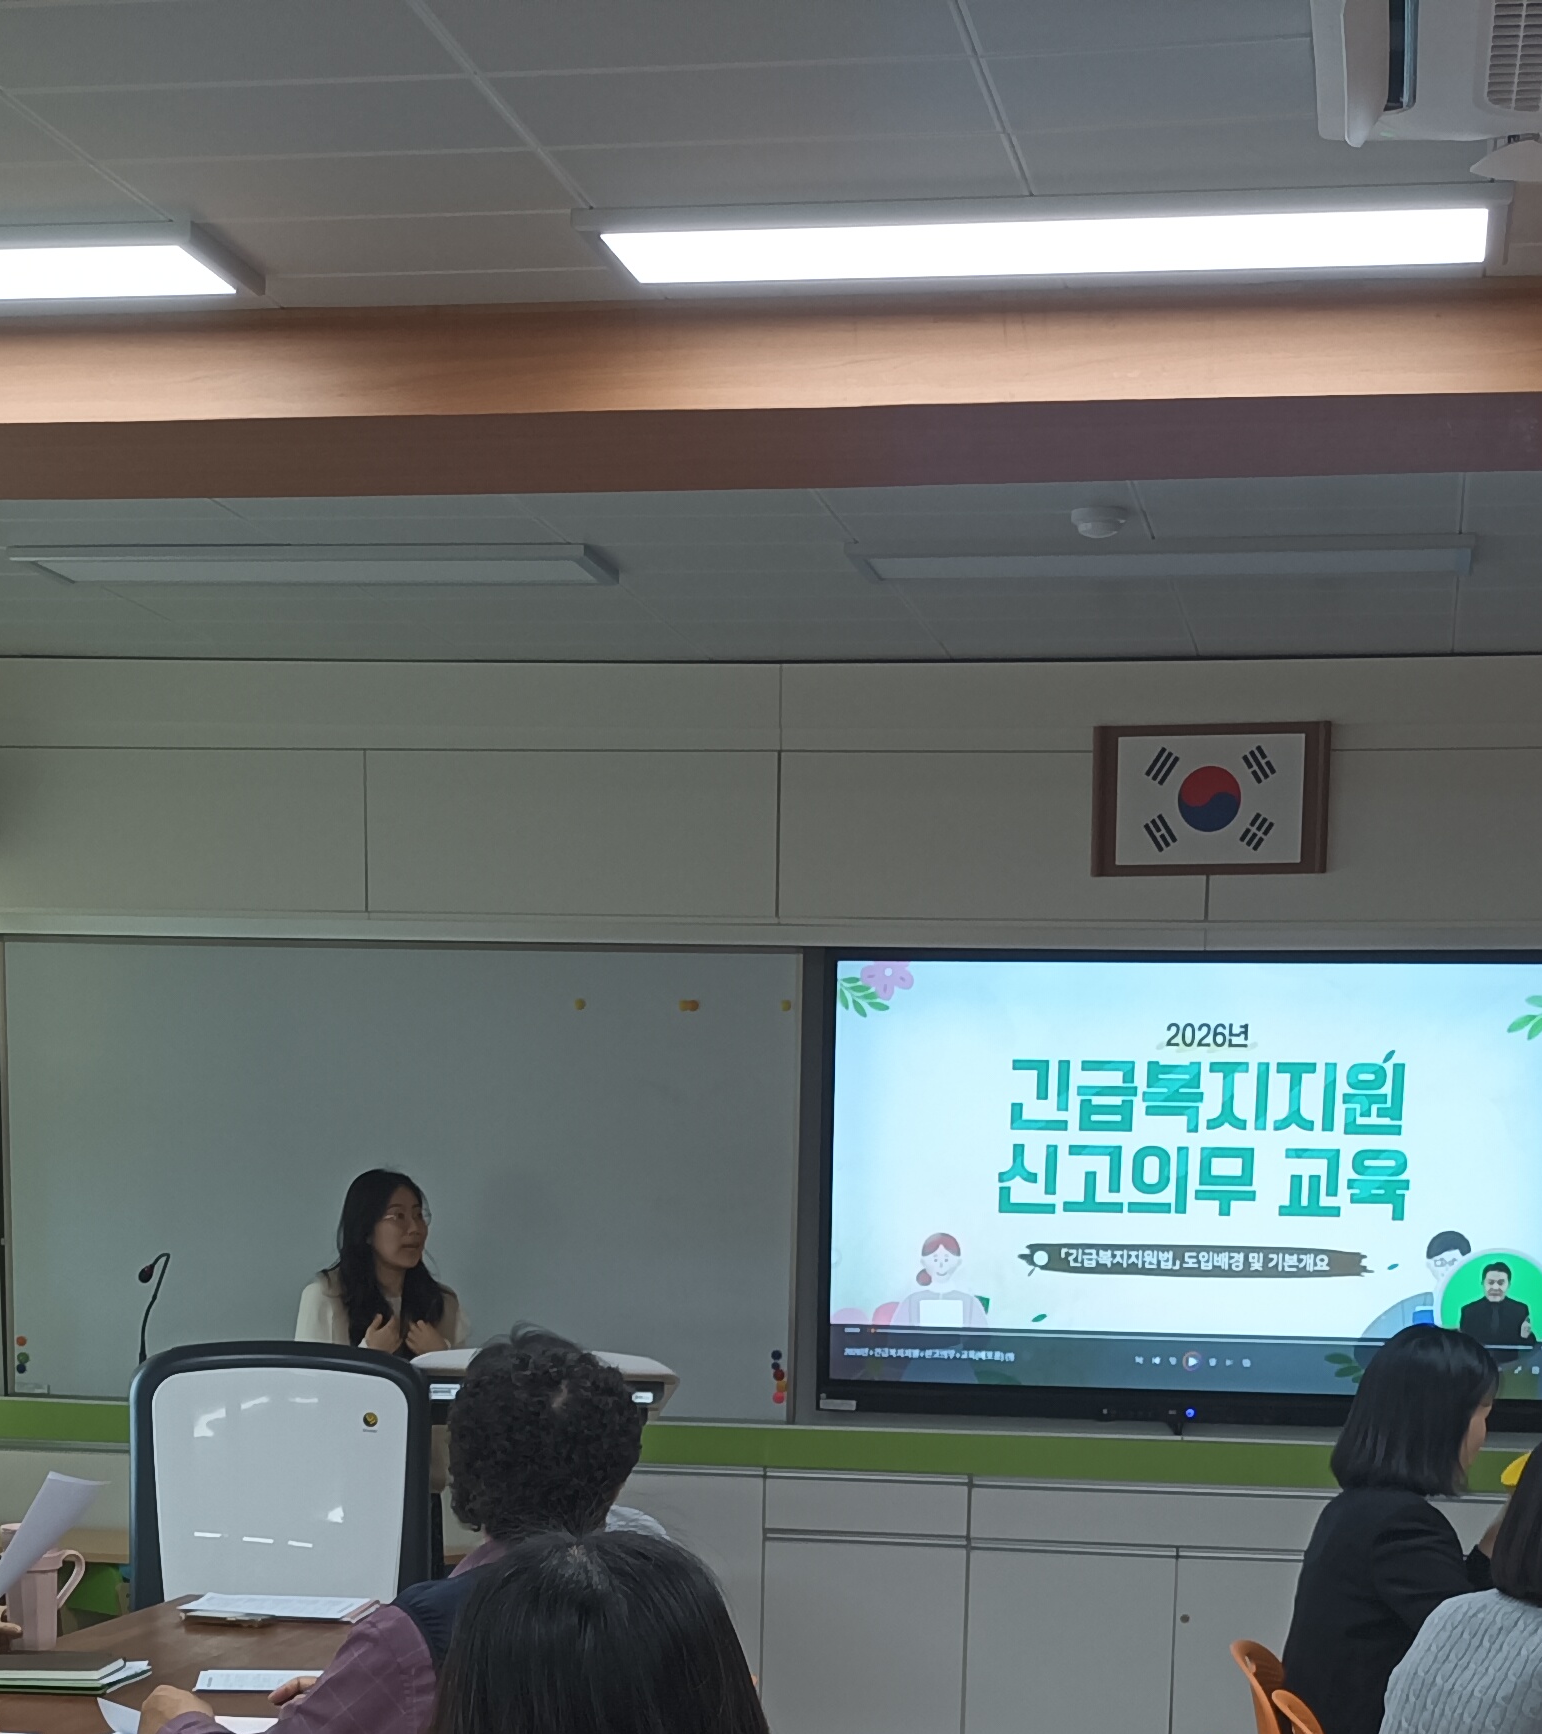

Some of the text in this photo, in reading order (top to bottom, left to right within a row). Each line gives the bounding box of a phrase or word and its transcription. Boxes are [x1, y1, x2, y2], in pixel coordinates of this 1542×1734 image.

[1165, 1022, 1249, 1048] 2026년
[1010, 1058, 1406, 1136] 긴급복지지원
[998, 1143, 1411, 1221] 신고의무 교육
[1182, 1252, 1245, 1271] 도입배경
[1248, 1252, 1264, 1272] 및
[1267, 1253, 1330, 1272] 기본개요
